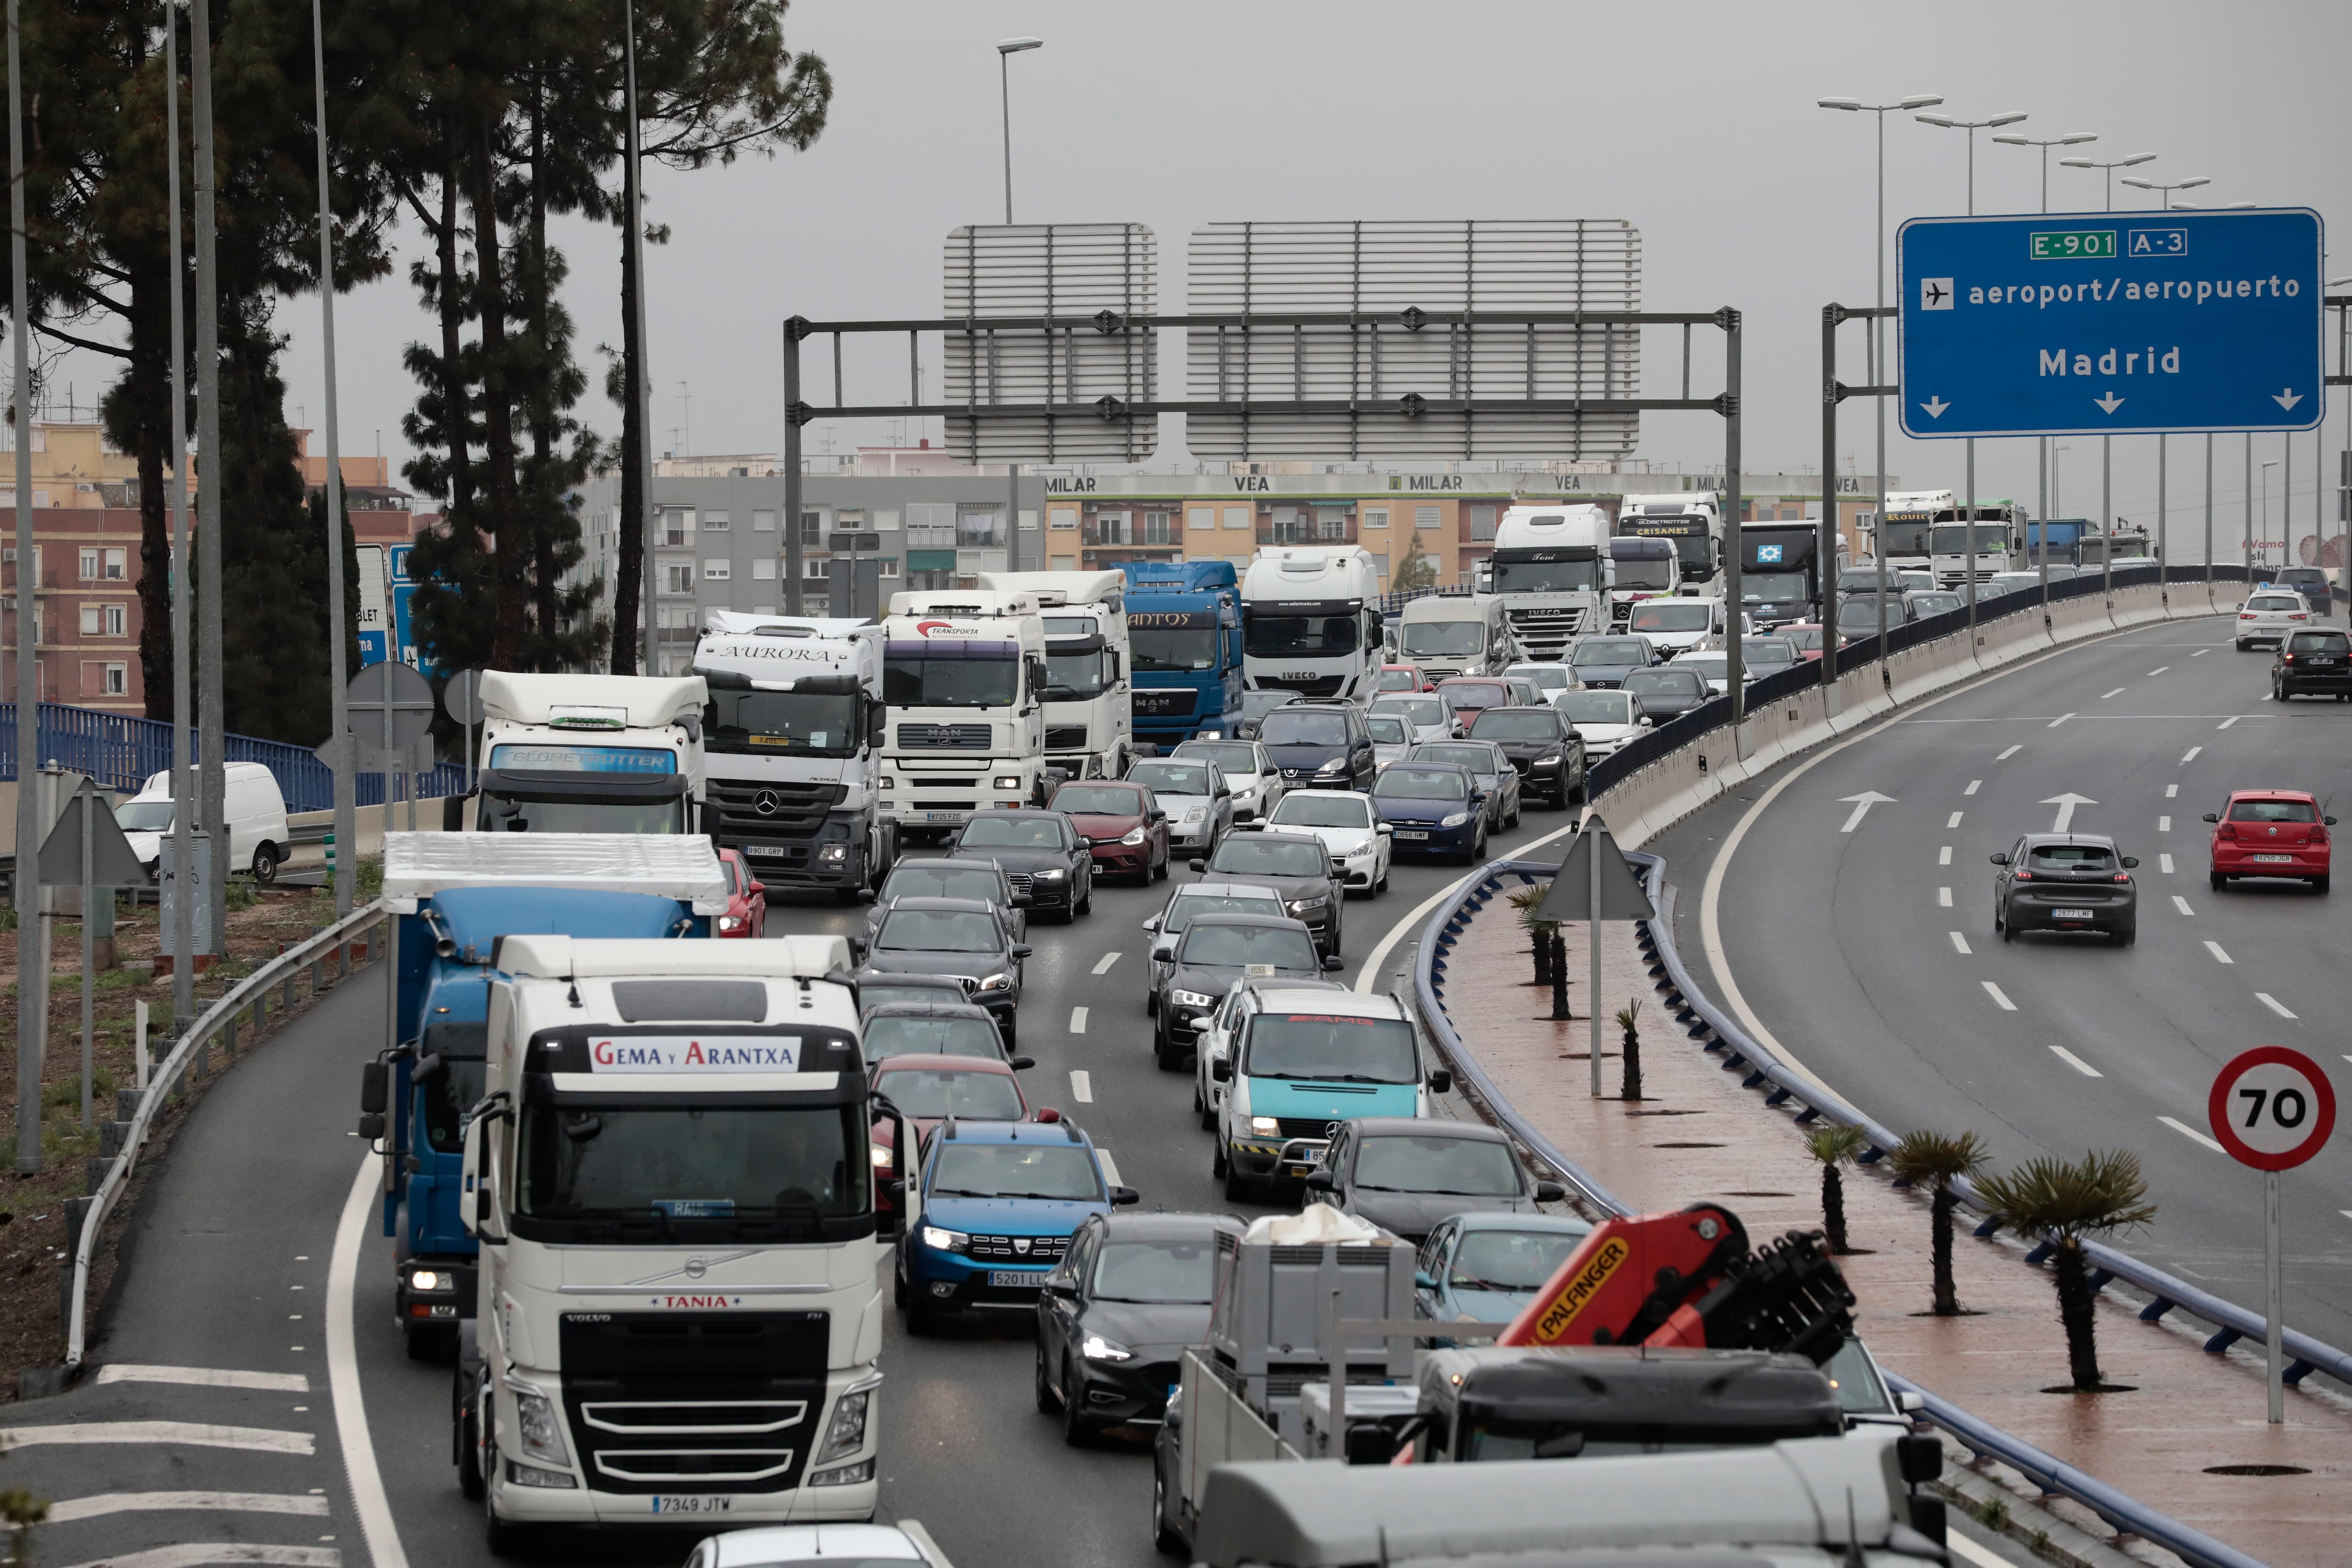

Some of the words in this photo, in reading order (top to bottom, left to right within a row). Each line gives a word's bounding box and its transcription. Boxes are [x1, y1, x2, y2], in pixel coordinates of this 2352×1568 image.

[2035, 235, 2113, 255] E-901
[2134, 234, 2183, 252] A-3
[1969, 275, 2300, 309] aeroport/aeropuerto
[2040, 346, 2179, 376] Madrid
[1045, 478, 1096, 492] MILAR
[1234, 477, 1270, 491] VEA
[1410, 476, 1462, 490] MILAR
[1555, 476, 1581, 490] VEA
[1698, 477, 1727, 491] MILA
[1836, 478, 1859, 492] VEA
[2242, 540, 2290, 549] #Vamo
[1126, 614, 1191, 625] ANTOS
[720, 646, 830, 661] AURORA
[512, 752, 665, 766] GLOBETROTTER
[1315, 1016, 1374, 1025] AMG
[2240, 1089, 2306, 1128] 70
[1313, 1151, 1324, 1160] 85
[996, 1274, 1024, 1285] 5201
[1030, 1274, 1043, 1285] LL
[1542, 1244, 1624, 1335] PALFINGER
[664, 1296, 728, 1308] TANIA
[567, 1314, 611, 1322] VOLVO
[663, 1497, 699, 1512] 7349
[704, 1497, 730, 1512] JTW
